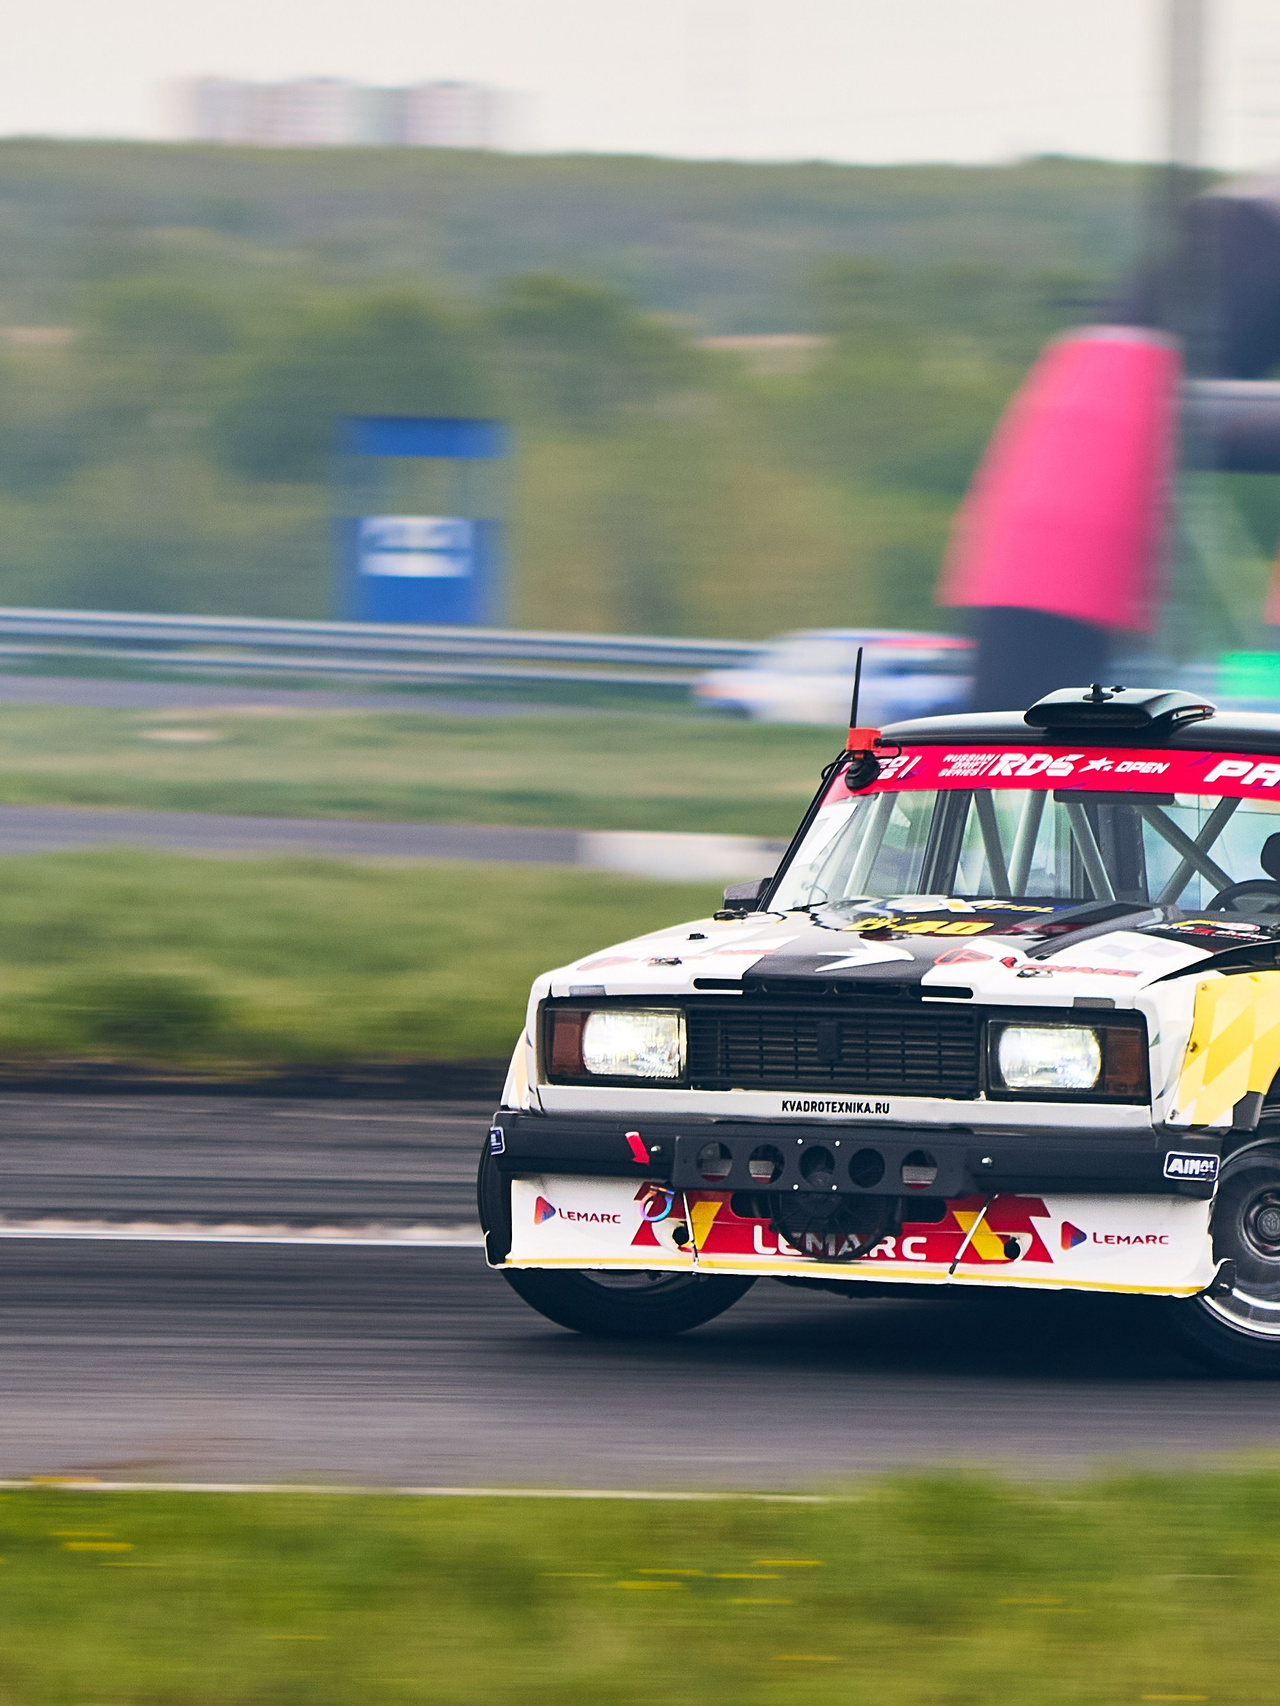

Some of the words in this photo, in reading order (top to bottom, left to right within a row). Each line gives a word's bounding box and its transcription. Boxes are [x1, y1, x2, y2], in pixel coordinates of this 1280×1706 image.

[943, 753, 996, 763] RUSSIAN
[988, 753, 1085, 777] RDS
[1114, 760, 1171, 774] OPEN
[938, 768, 981, 777] SERIES
[781, 1100, 890, 1115] KVADROTEXNIKA.RU
[558, 1207, 622, 1225] LEMARC
[1092, 1231, 1170, 1246] LEMARC
